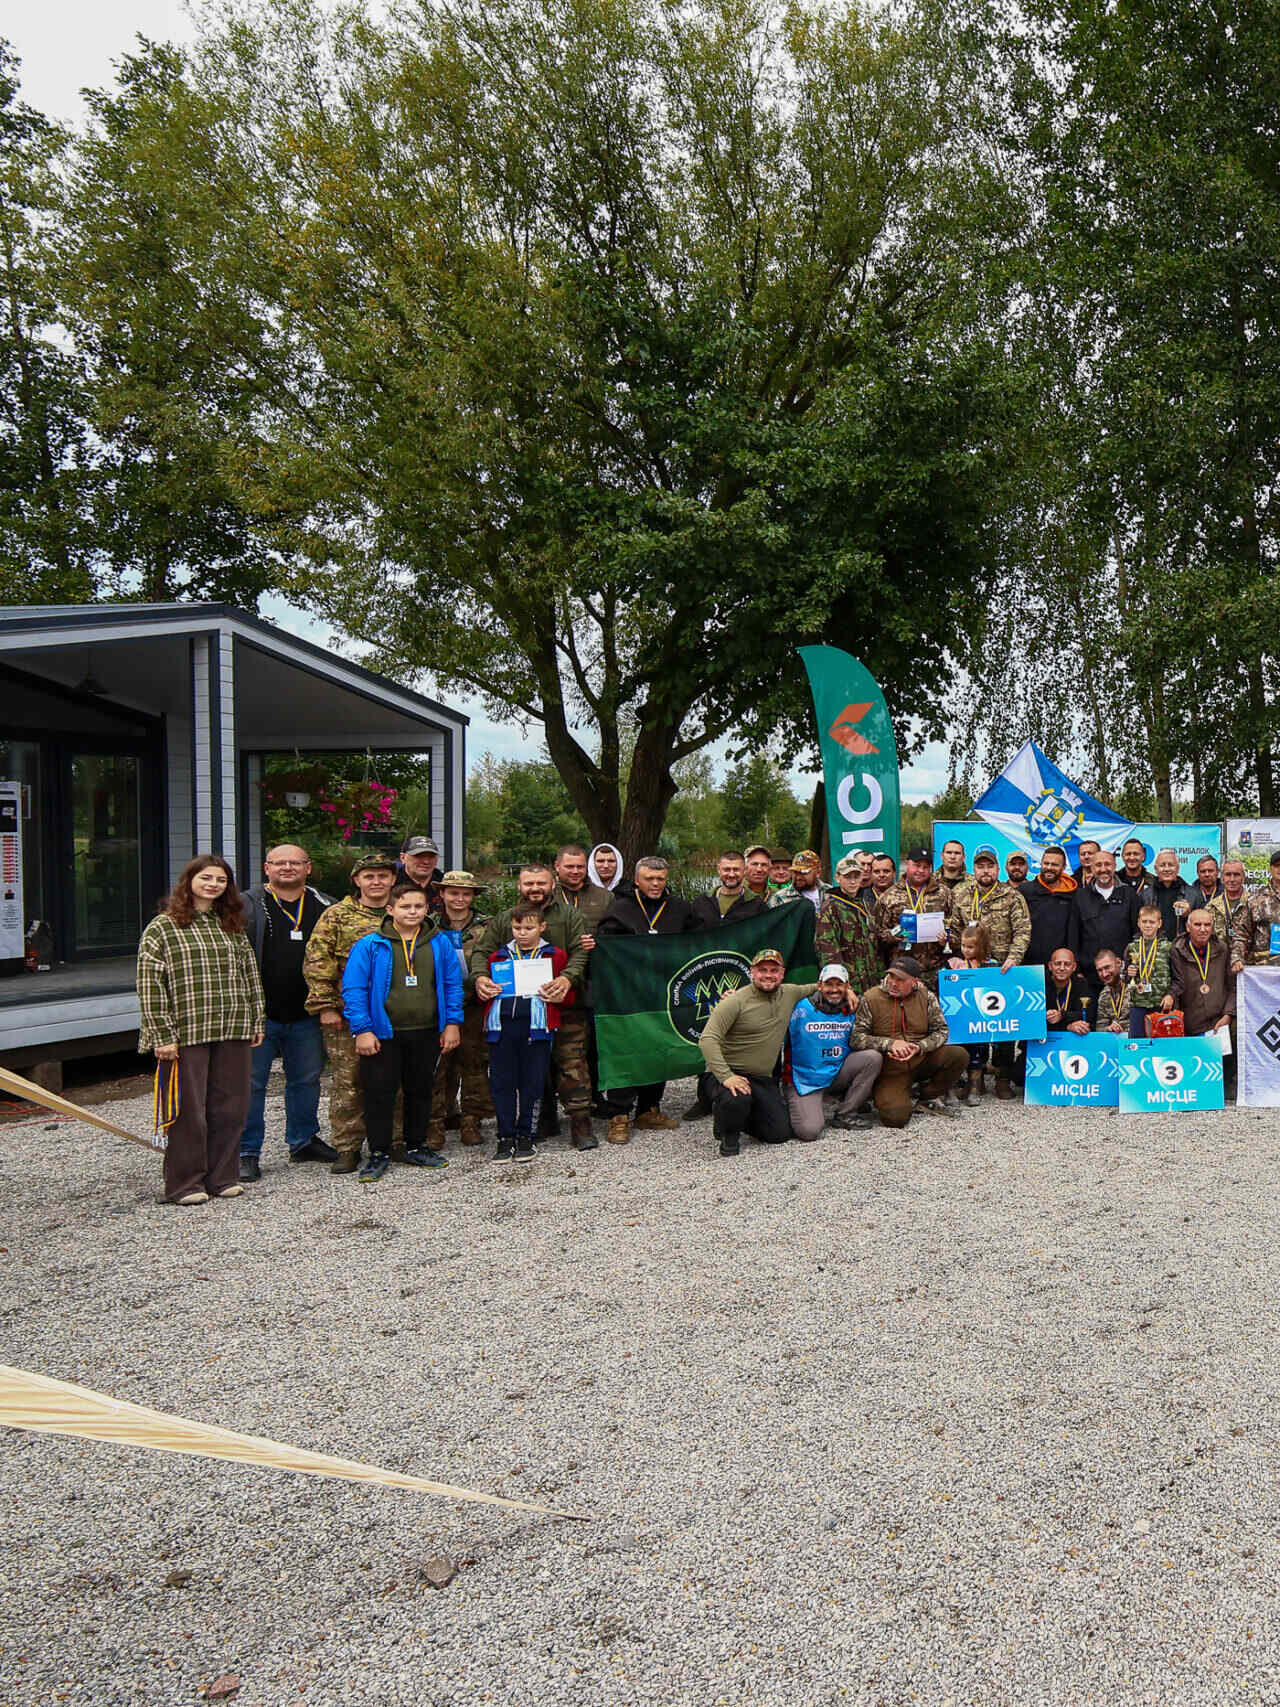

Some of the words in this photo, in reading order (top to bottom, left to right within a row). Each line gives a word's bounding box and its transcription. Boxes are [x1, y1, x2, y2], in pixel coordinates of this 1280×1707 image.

[986, 996, 1000, 1011] 2
[968, 1018, 1020, 1034] МІСЦЕ
[1070, 1060, 1080, 1074] 1
[1165, 1066, 1178, 1080] 3
[1051, 1084, 1100, 1098] МІСЦЕ
[1147, 1090, 1197, 1104] МІСЦЕ
